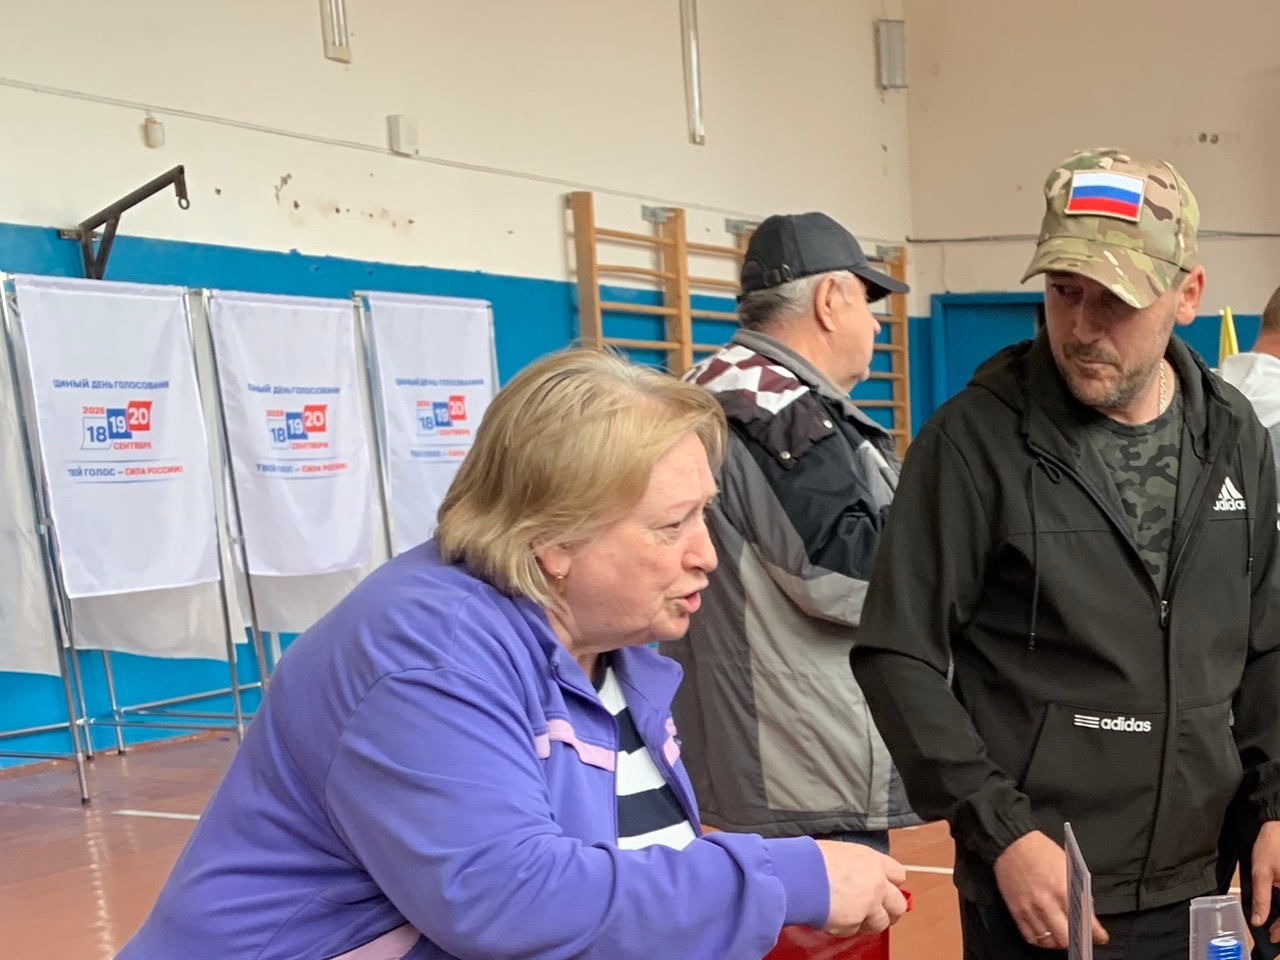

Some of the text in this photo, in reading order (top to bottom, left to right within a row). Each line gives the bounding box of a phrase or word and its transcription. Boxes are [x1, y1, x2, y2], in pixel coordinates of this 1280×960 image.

[92, 380, 113, 390] ДЕНЬ
[86, 407, 149, 443] 18 19 20
[419, 400, 465, 430] 18 19 20
[270, 411, 324, 443] 18 19 20
[84, 468, 116, 477] ГОЛОС
[124, 467, 146, 476] СИЛА
[1100, 716, 1152, 732] adidas
